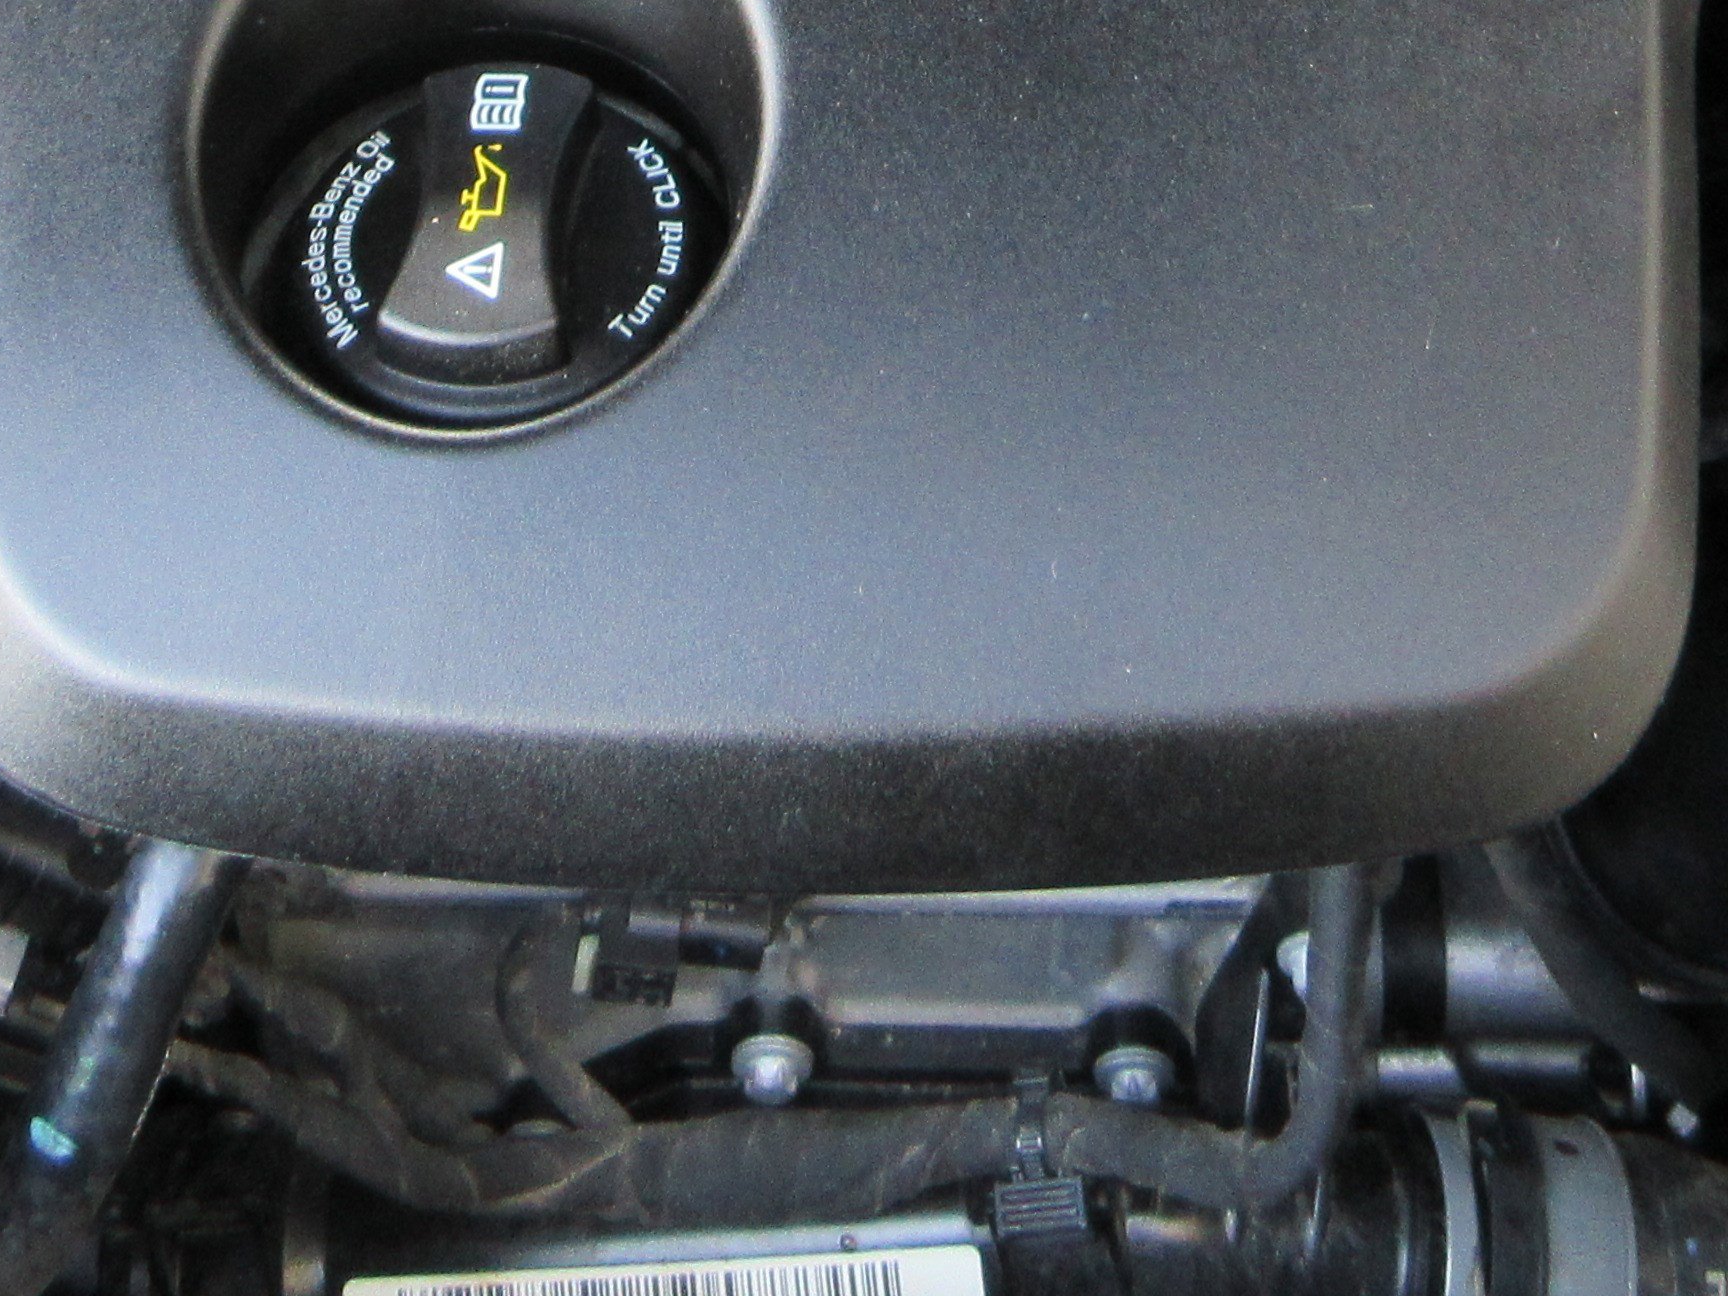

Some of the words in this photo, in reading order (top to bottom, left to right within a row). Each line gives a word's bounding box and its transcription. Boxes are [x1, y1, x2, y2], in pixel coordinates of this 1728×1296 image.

[627, 138, 680, 209] CLICK
[301, 161, 361, 350] Mercedes-Benz
[356, 130, 390, 159] Oil
[333, 153, 394, 313] recommended
[657, 220, 683, 276] until
[607, 283, 667, 339] Turn
